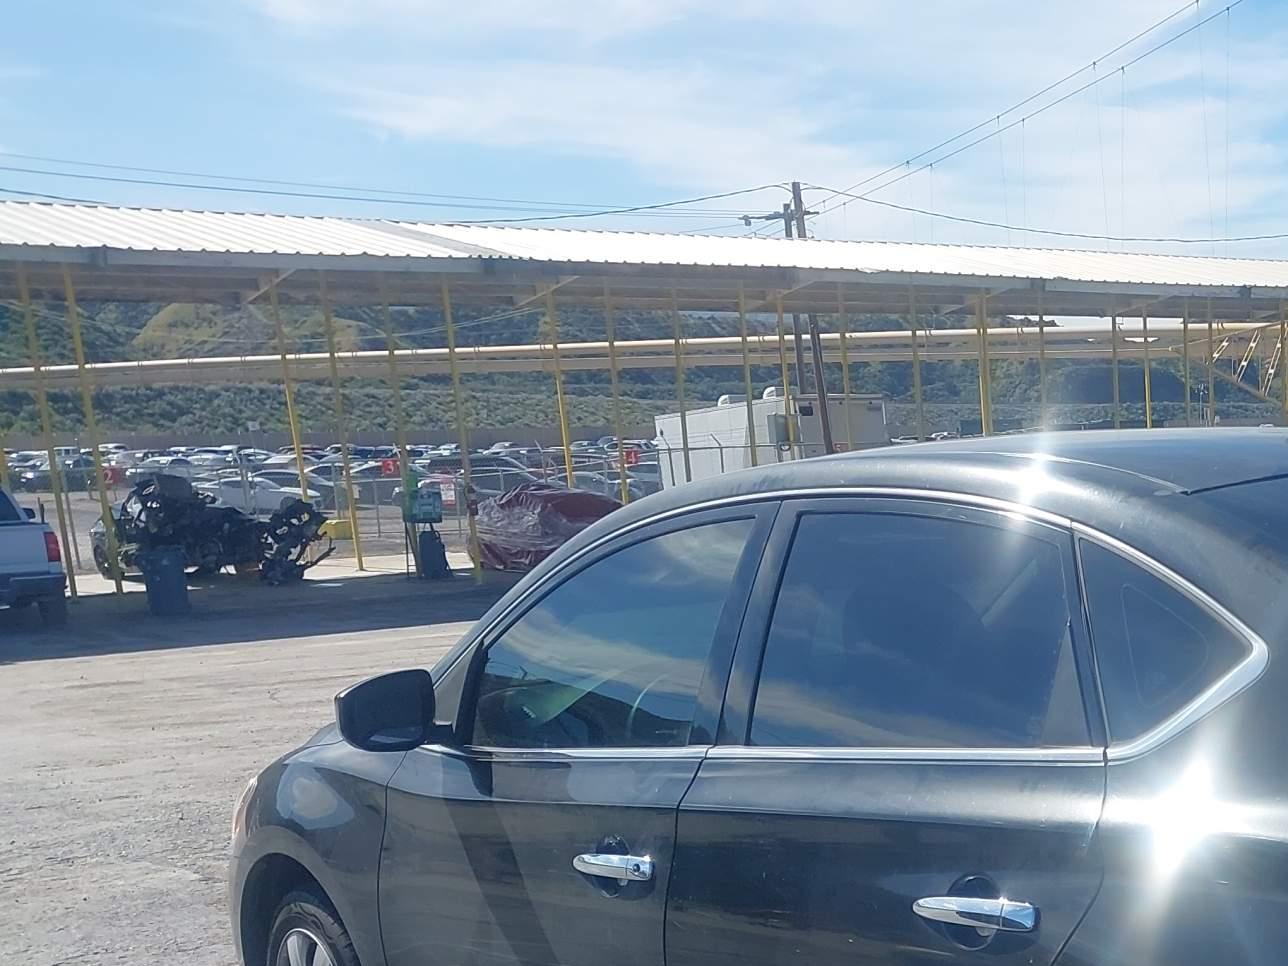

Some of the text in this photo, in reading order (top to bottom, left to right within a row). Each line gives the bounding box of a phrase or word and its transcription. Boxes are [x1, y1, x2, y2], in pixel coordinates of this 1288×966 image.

[626, 451, 636, 464] 4
[384, 460, 395, 474] 3
[103, 469, 114, 484] 2
